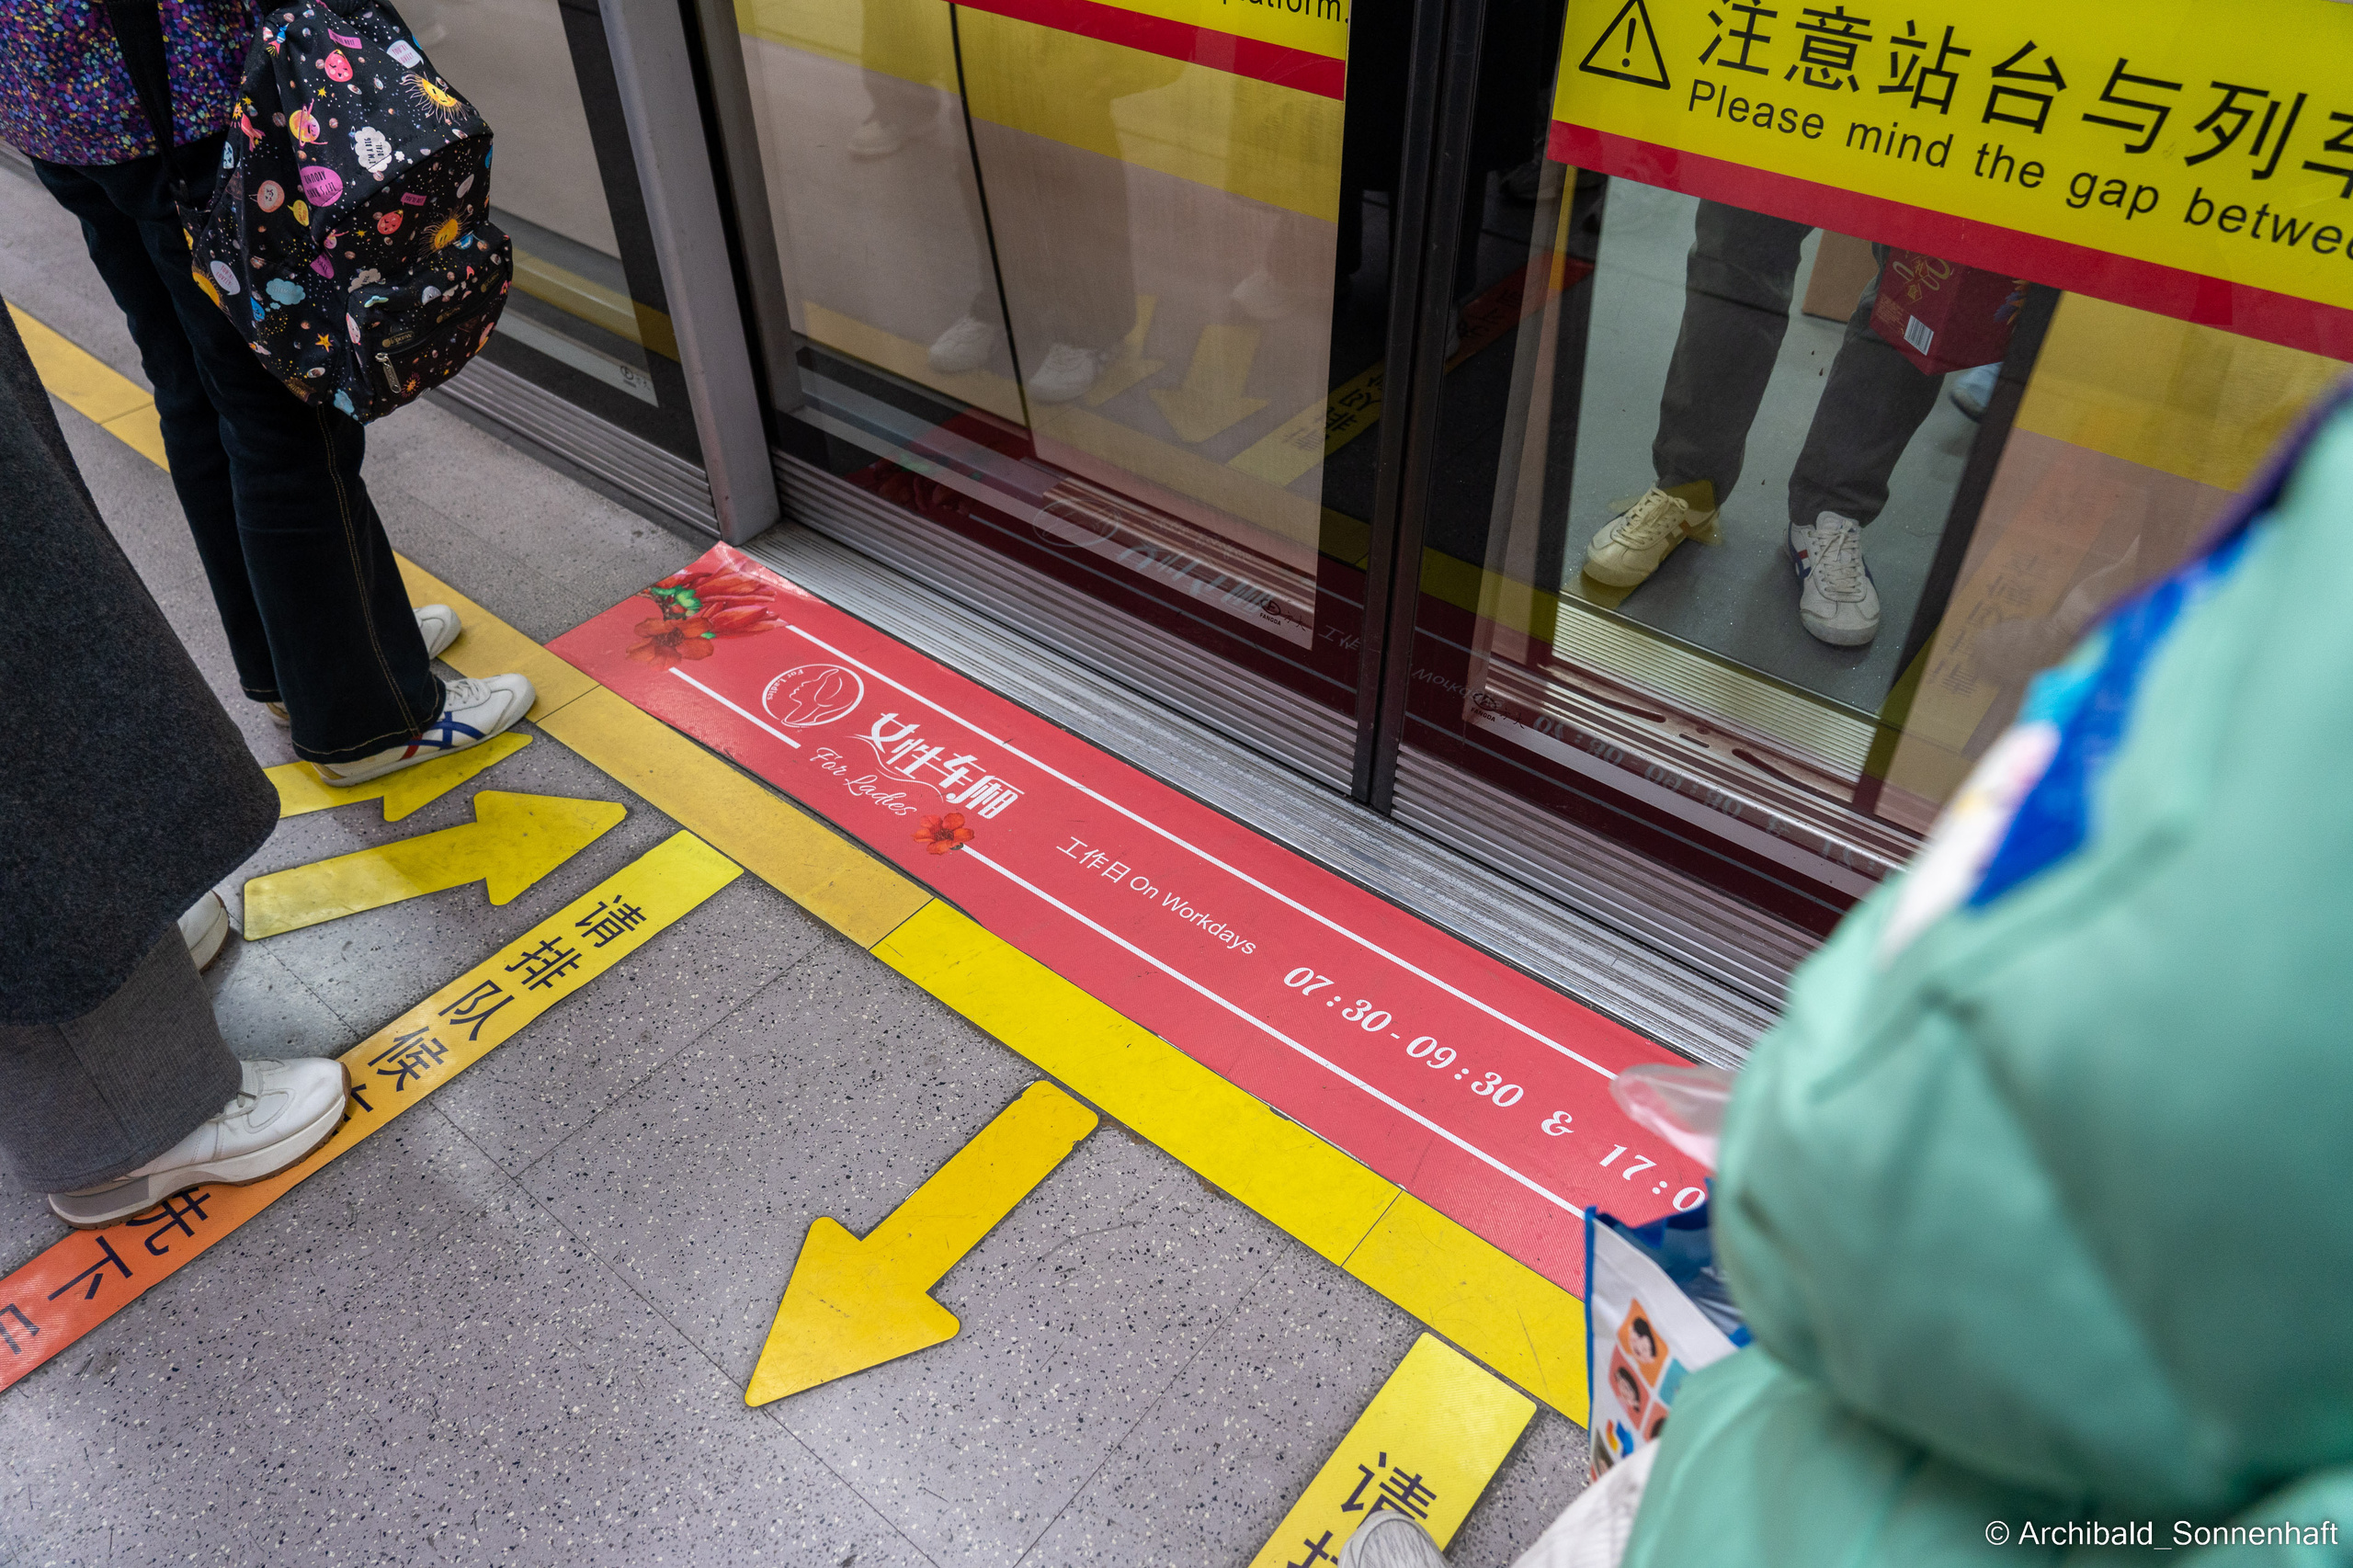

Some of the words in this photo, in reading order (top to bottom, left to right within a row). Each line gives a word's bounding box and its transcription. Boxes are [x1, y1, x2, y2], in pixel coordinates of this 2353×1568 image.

[1688, 78, 1825, 140] Please
[1845, 121, 1954, 169] mind
[1973, 142, 2046, 189] the
[2065, 172, 2161, 221] gap
[2183, 187, 2353, 261] betwe
[1259, 612, 1281, 626] FANGDA
[1471, 707, 1495, 722] FANGDA
[809, 746, 848, 777] For
[842, 774, 917, 816] Ladies
[870, 712, 1026, 820] 女性车厢
[1055, 835, 1131, 884] 工作日
[1130, 875, 1159, 900] On
[1161, 892, 1257, 956] Workdays
[332, 894, 648, 1137] 请排队候
[1540, 1109, 1574, 1137] &
